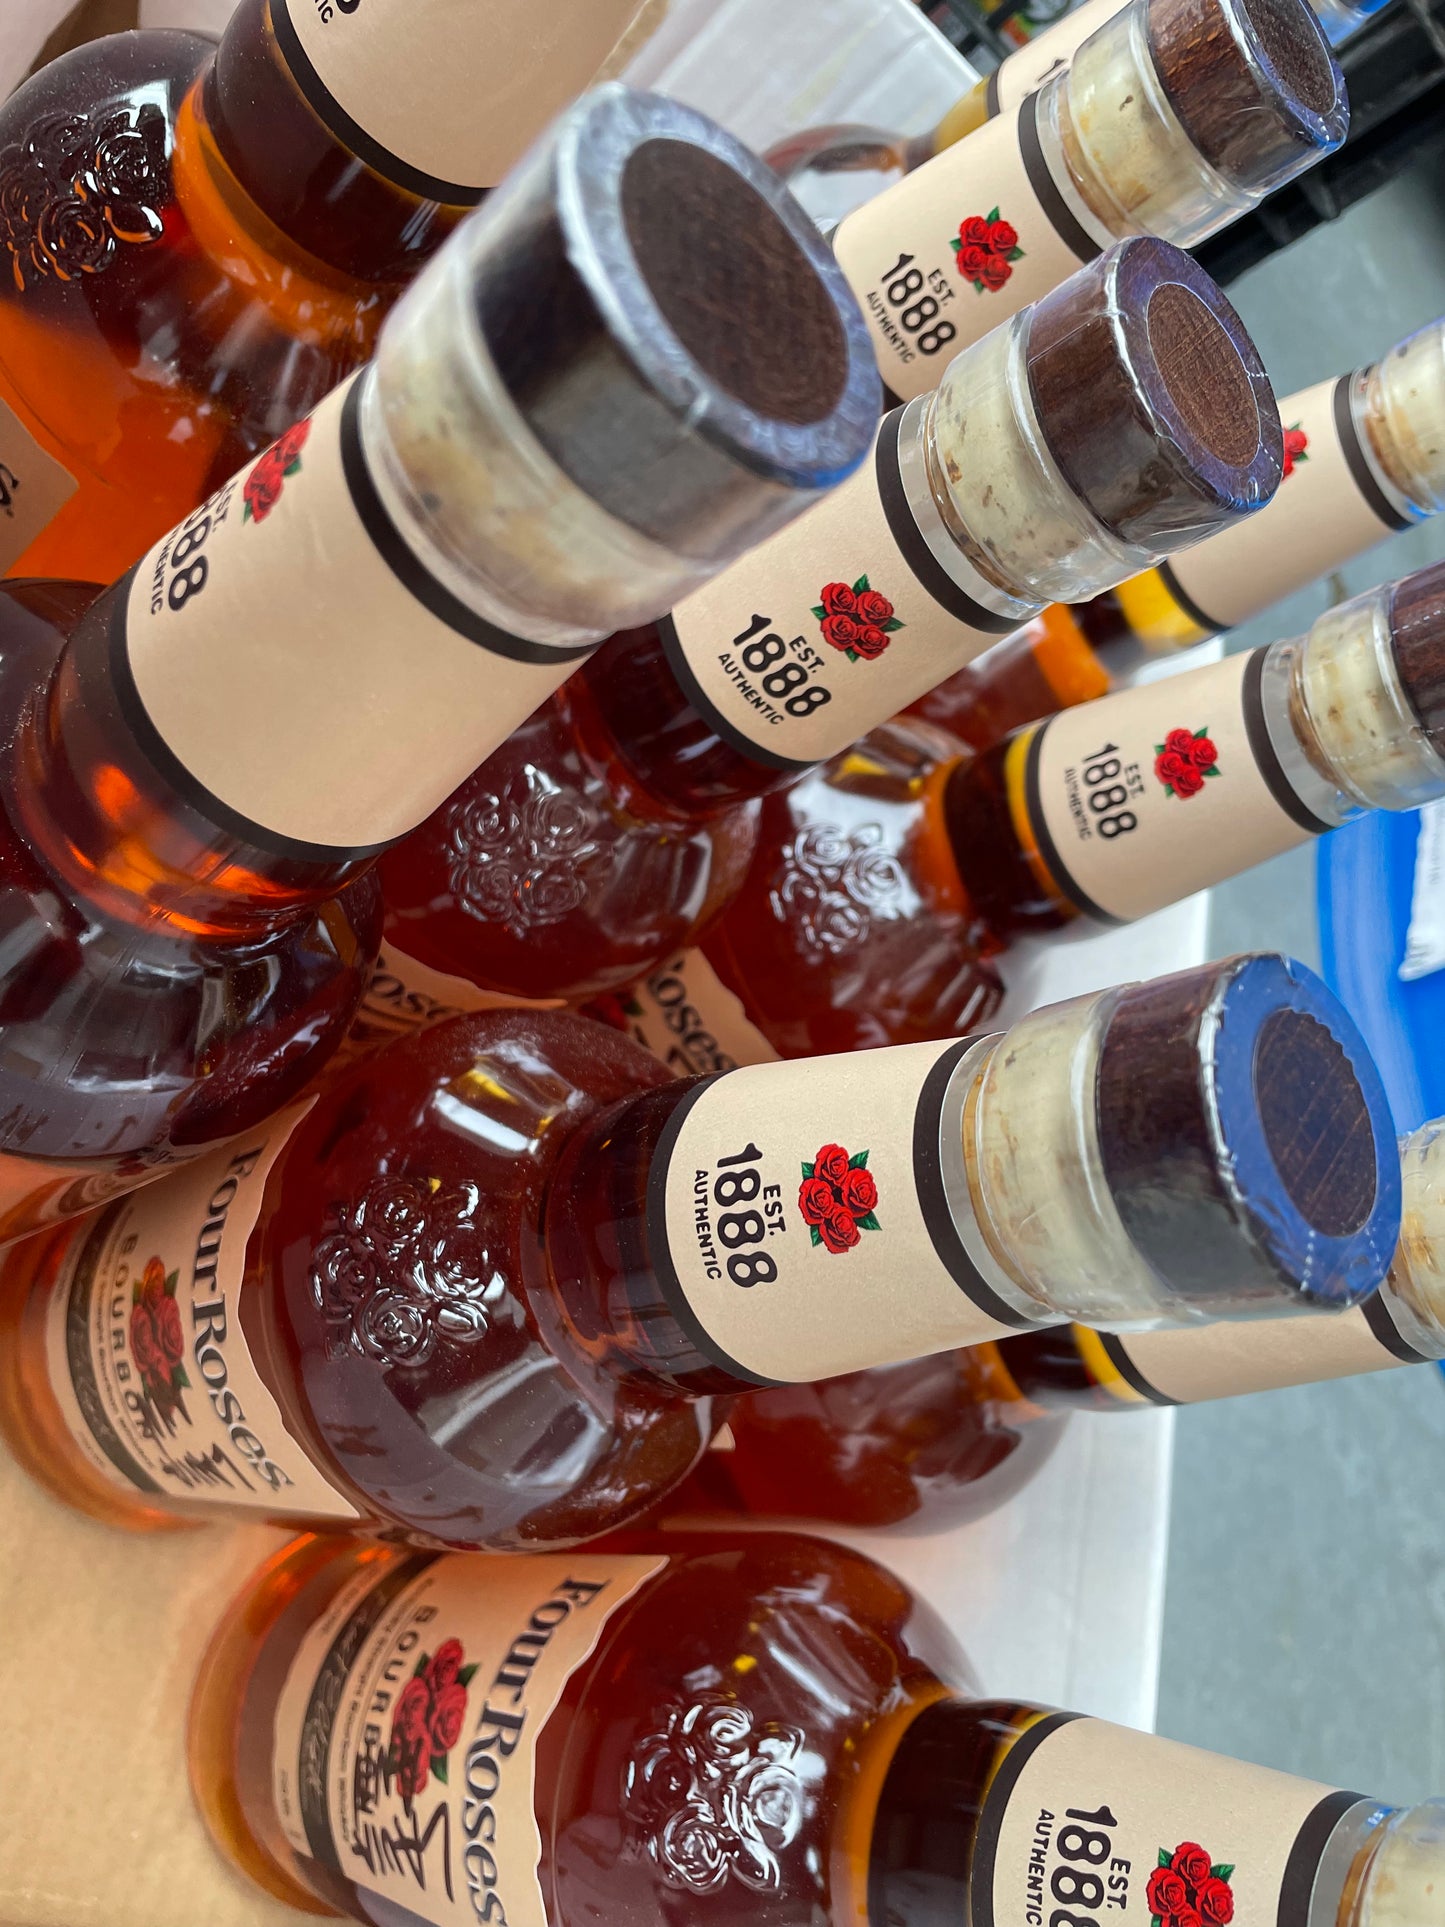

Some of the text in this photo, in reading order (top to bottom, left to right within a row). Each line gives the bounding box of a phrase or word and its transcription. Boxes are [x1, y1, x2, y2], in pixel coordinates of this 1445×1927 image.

[866, 291, 916, 364] AUTHENTIC
[881, 253, 957, 356] 1888
[927, 267, 955, 307] EST.
[718, 653, 785, 725] AUTHENTIC
[733, 613, 832, 718] 1888
[788, 635, 825, 673] EST.
[1081, 743, 1138, 839] 1888
[647, 957, 738, 1074] oses
[192, 1139, 269, 1292] Four
[693, 1169, 723, 1280] AUTHENTIC
[713, 1142, 778, 1288] 1888
[763, 1184, 786, 1236] EST.
[110, 1233, 154, 1439] BOURBON
[192, 1291, 295, 1492] Roses
[356, 1604, 439, 1814] BOURBON
[463, 1576, 611, 1927] Four Roses
[1025, 1808, 1055, 1926] AUTHENTIC
[1106, 1857, 1131, 1910] EST.
